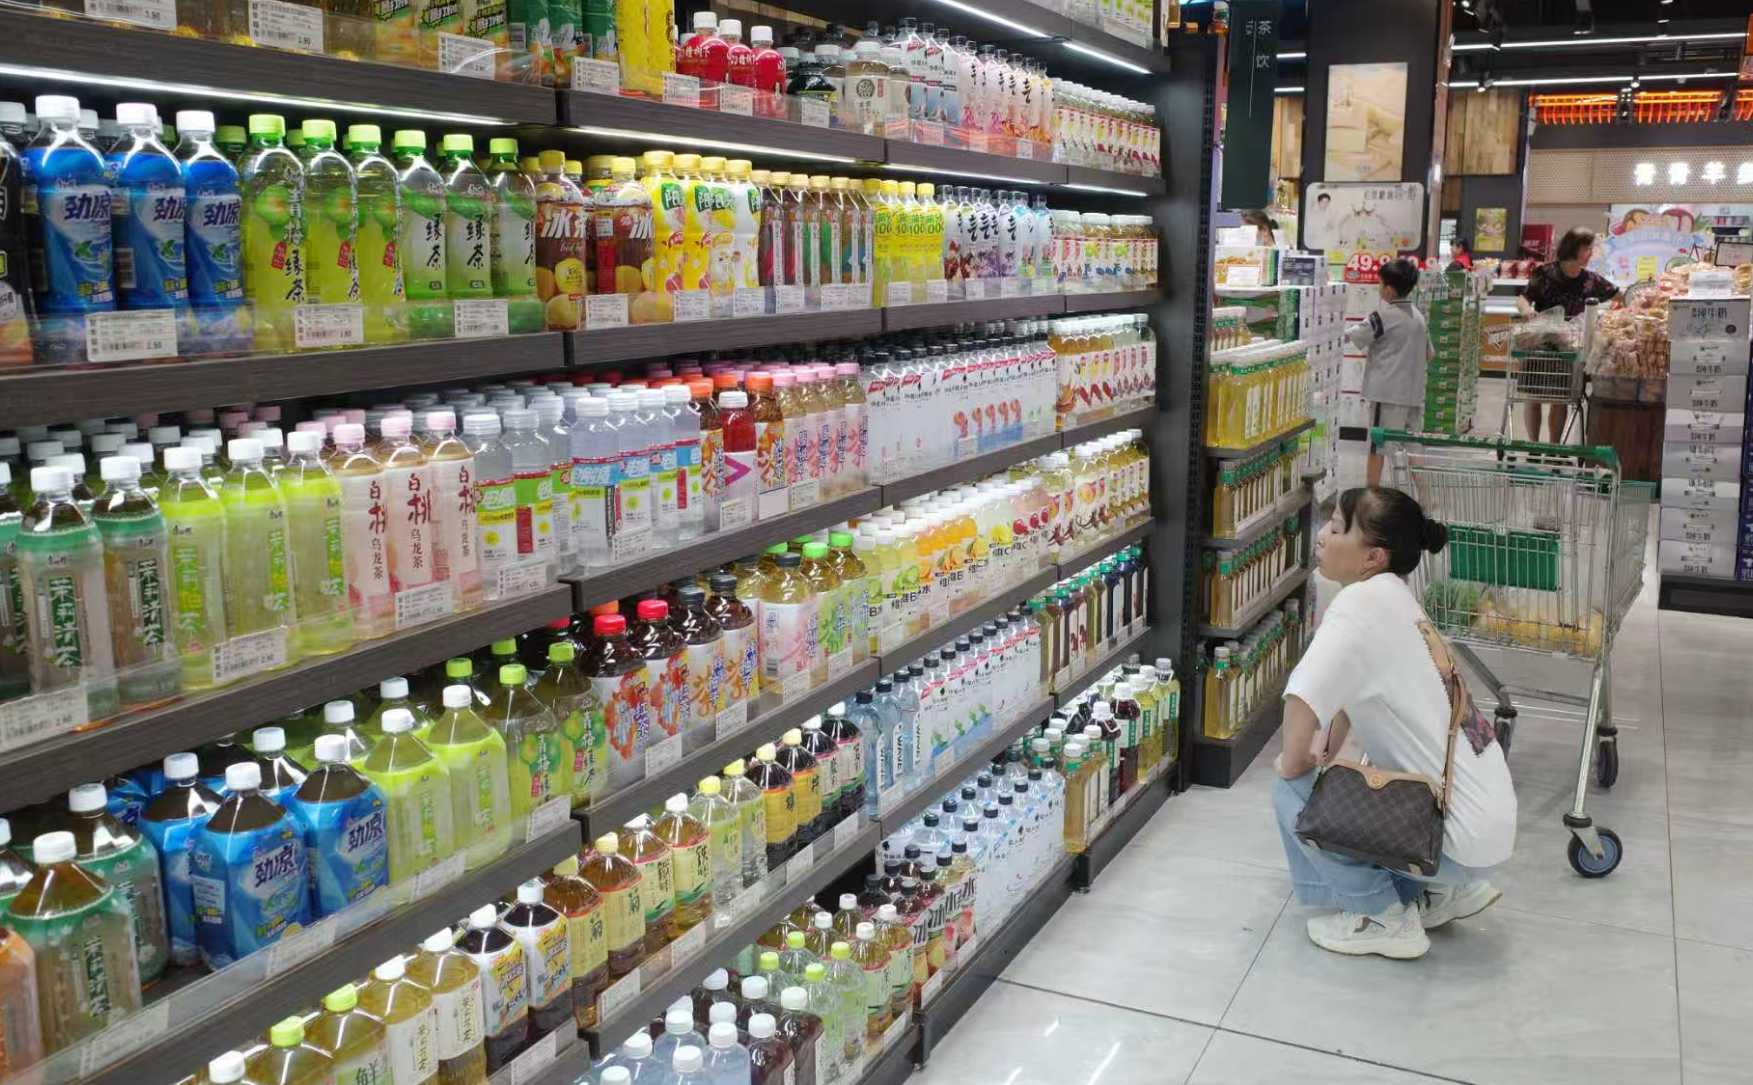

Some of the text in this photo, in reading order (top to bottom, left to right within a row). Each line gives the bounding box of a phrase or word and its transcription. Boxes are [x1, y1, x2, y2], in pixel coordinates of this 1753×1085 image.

[1255, 20, 1273, 69] 茶饮
[64, 193, 111, 222] 劲凉
[204, 200, 240, 228] 劲凉
[426, 213, 443, 271] 绿茶
[466, 213, 485, 270] 绿茶
[50, 577, 83, 674] 茉莉清茶
[138, 560, 164, 656] 茉莉清茶
[348, 815, 384, 853] 劲凉
[255, 844, 297, 889] 劲凉
